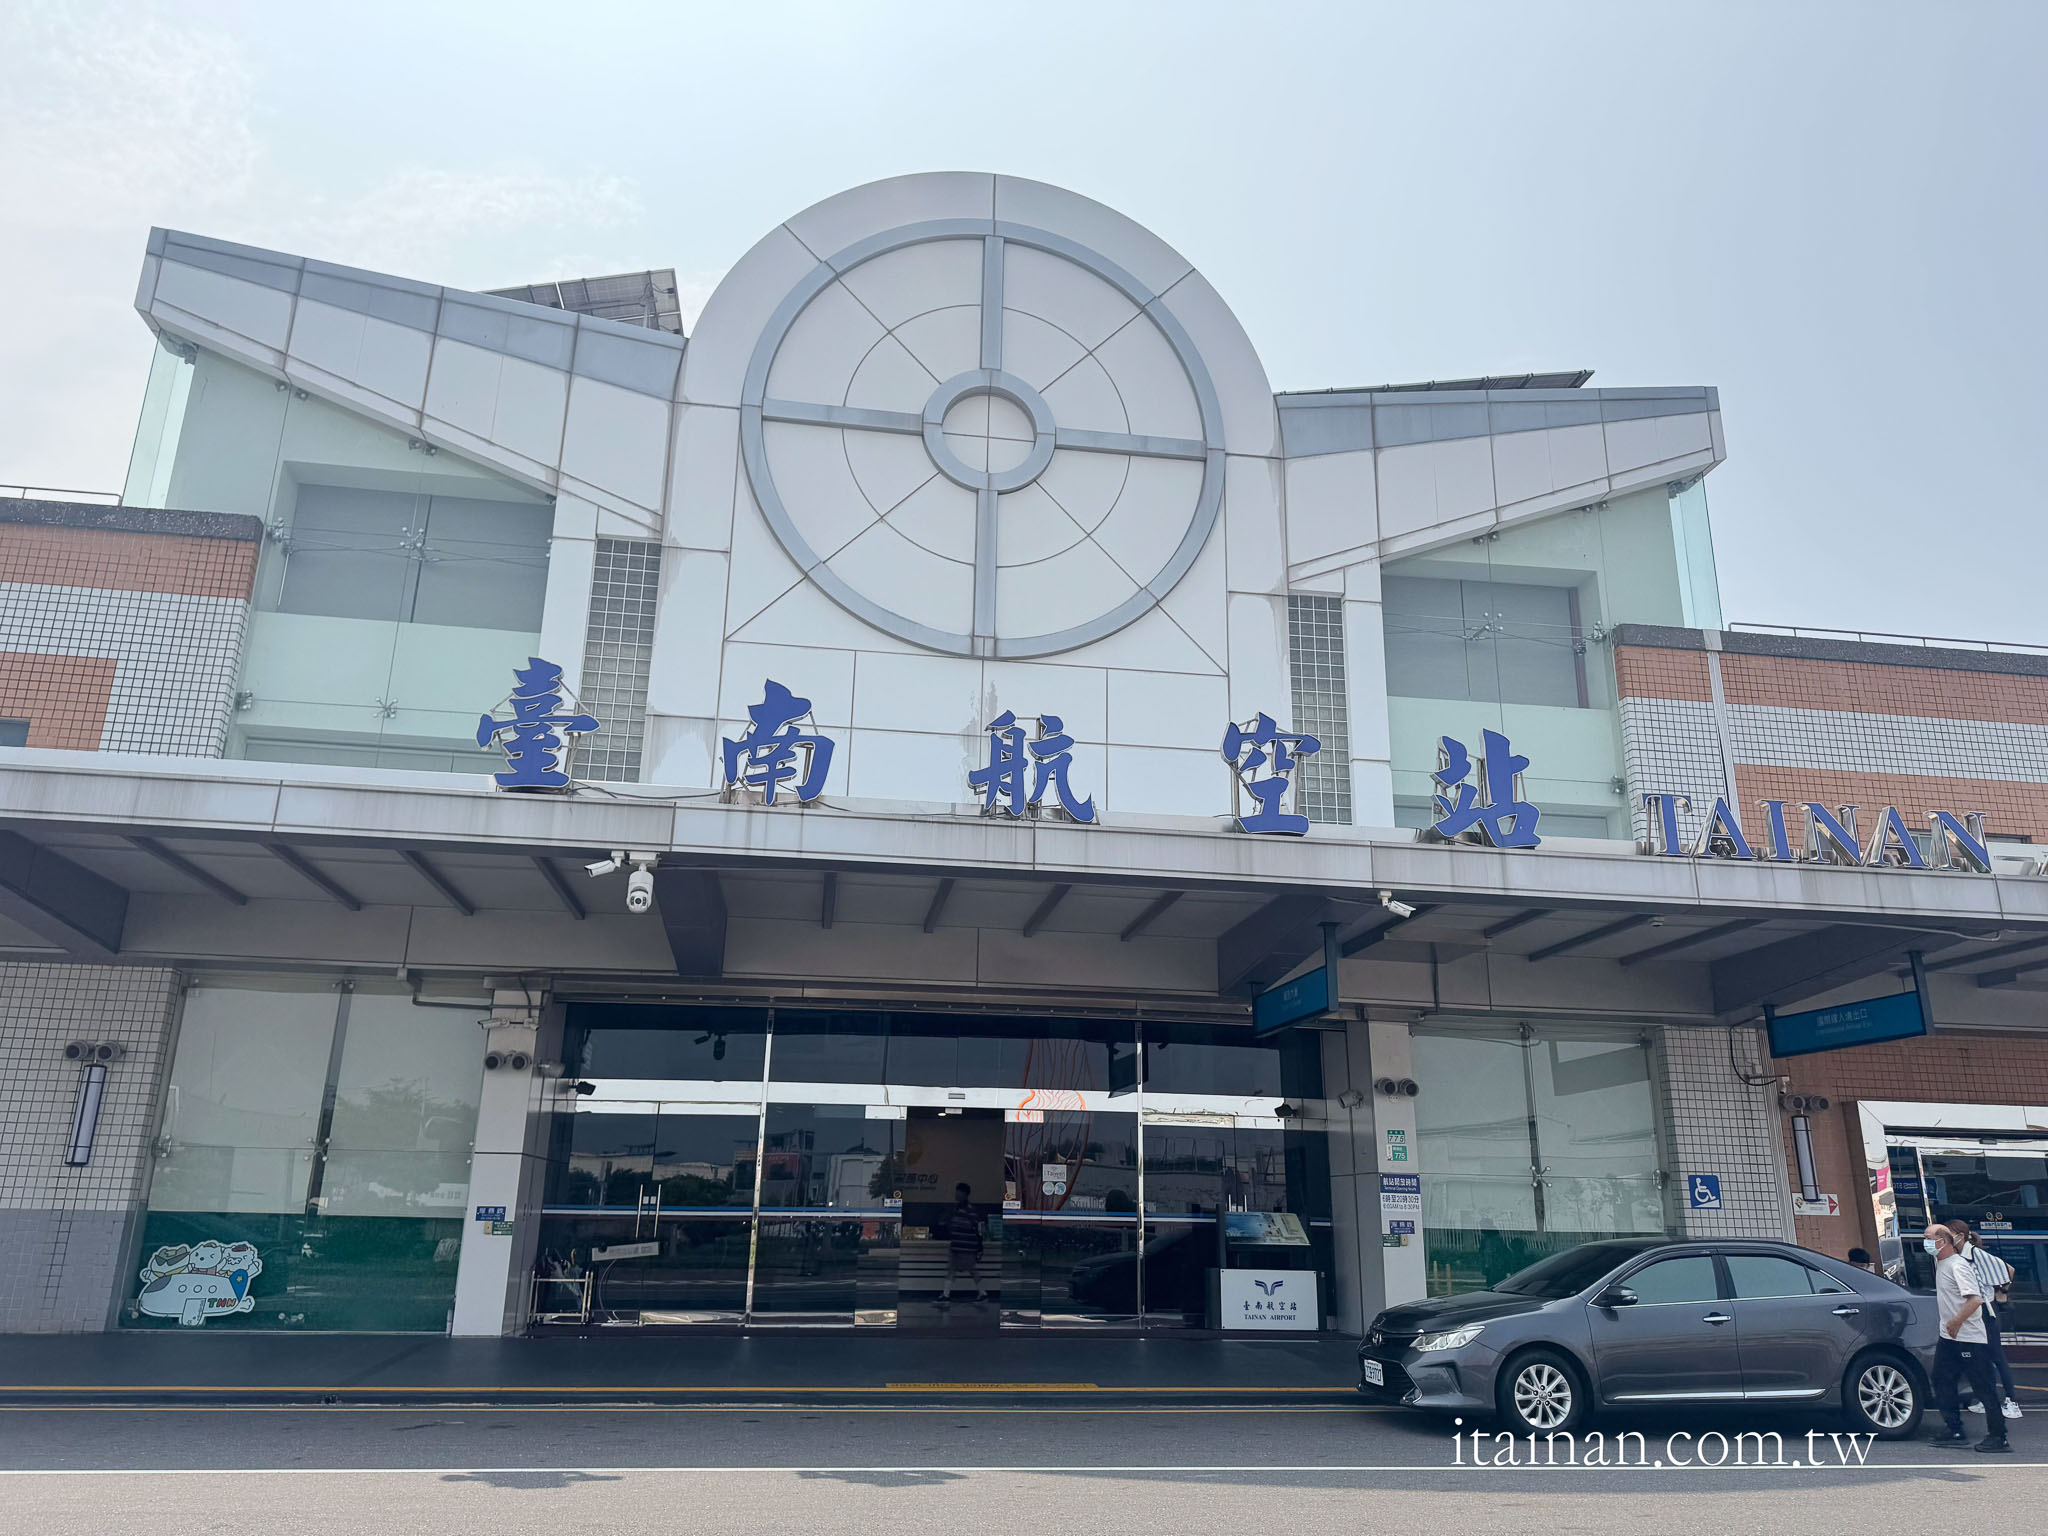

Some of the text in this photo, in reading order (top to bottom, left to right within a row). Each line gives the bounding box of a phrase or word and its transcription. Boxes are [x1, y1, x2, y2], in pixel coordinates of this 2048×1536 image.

[477, 656, 1542, 849] 臺南航空站
[1641, 793, 1992, 873] TAINAN
[1389, 1135, 1404, 1143] 775
[1394, 1152, 1406, 1160] 775
